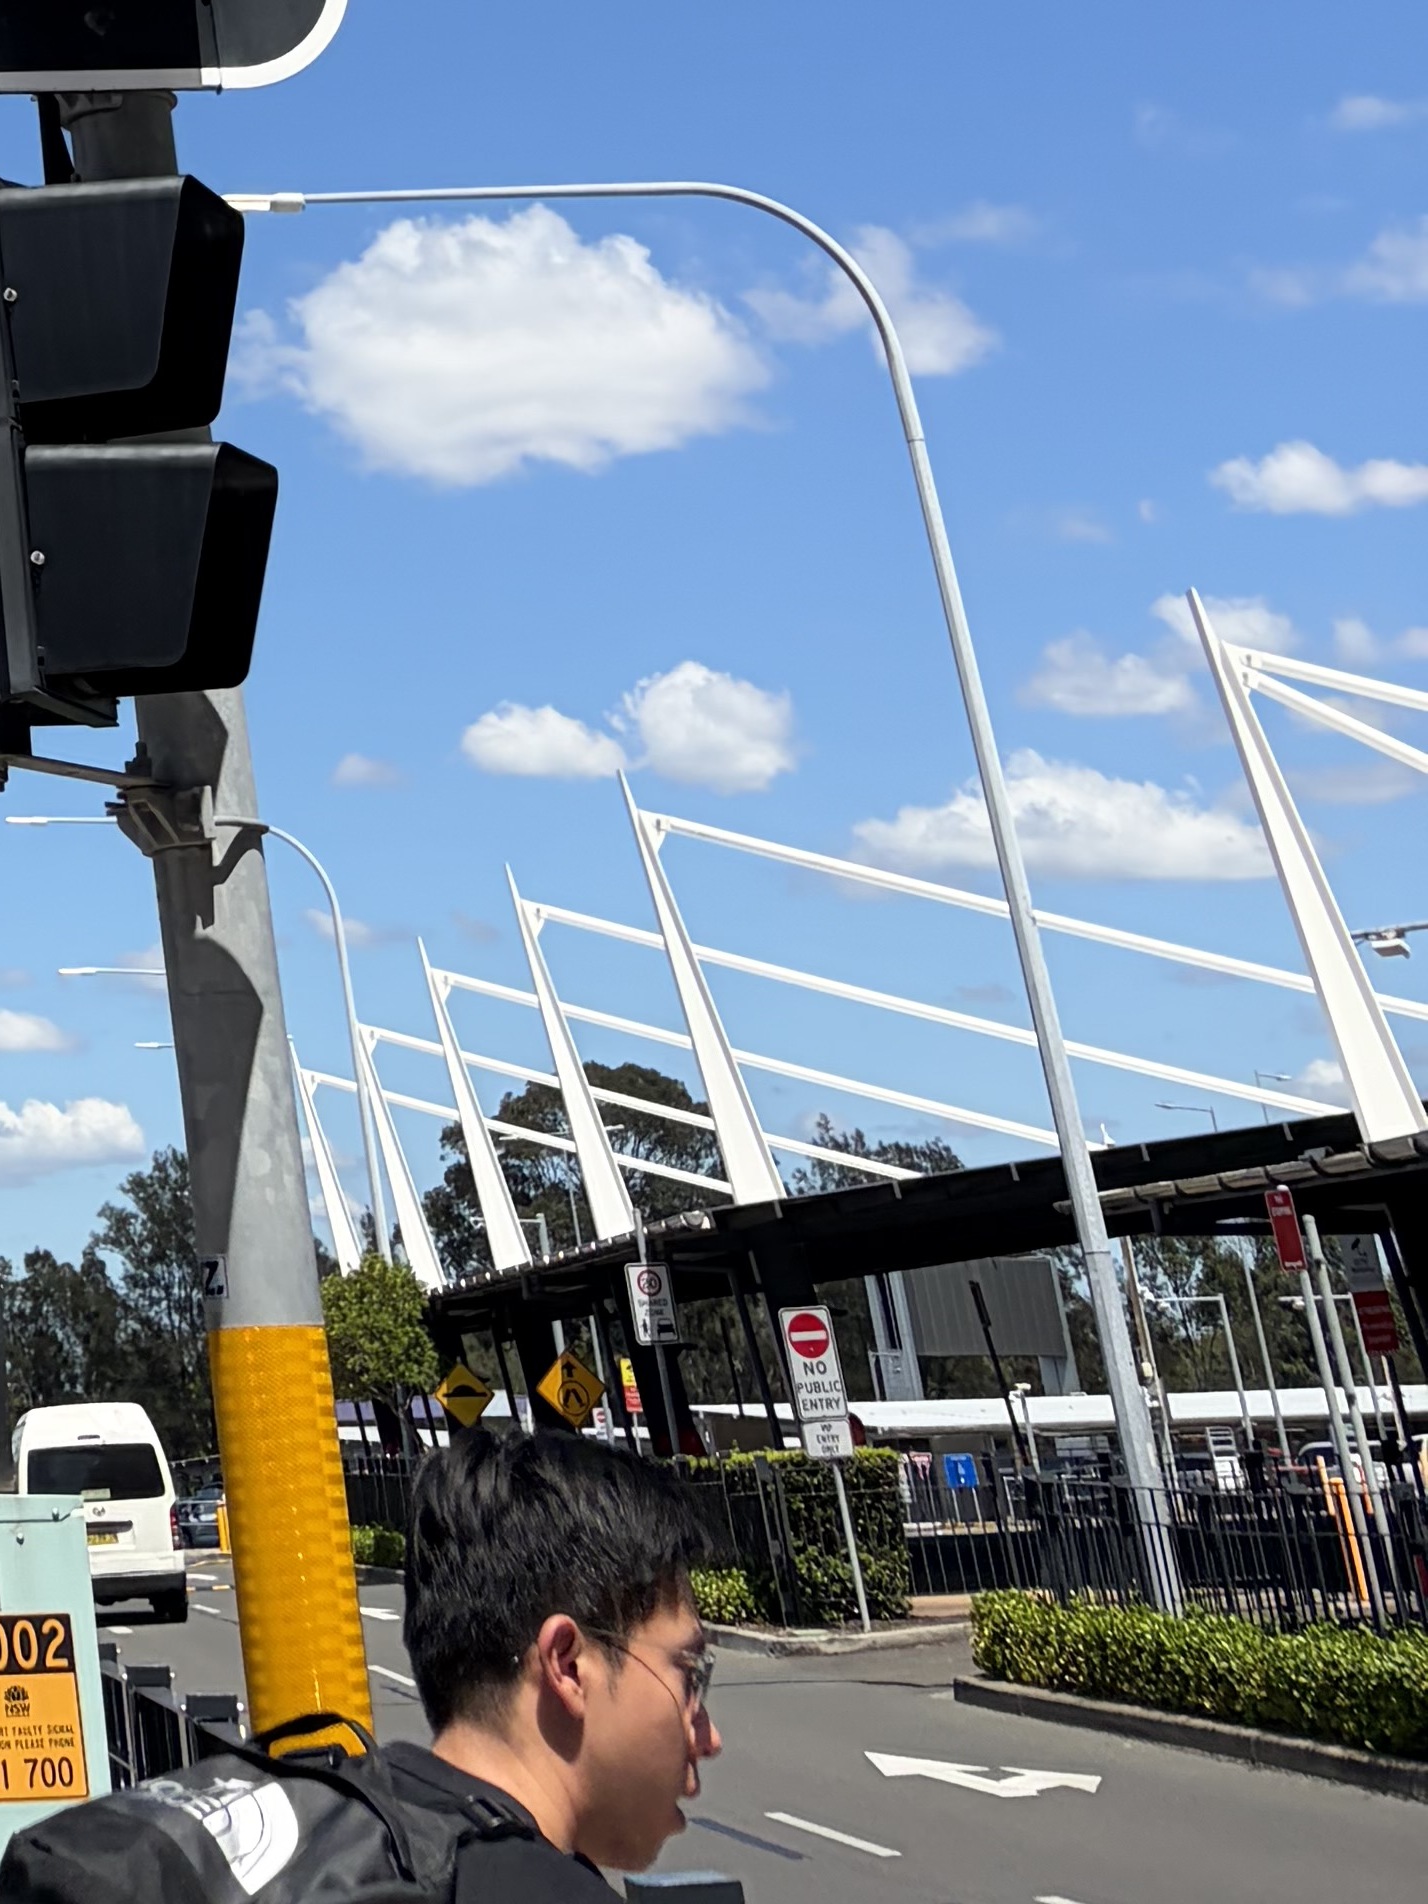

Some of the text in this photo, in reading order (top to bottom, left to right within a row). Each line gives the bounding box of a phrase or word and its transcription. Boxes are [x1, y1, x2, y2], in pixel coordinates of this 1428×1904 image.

[803, 1360, 827, 1376] NO
[797, 1380, 842, 1394] PUBLIC
[802, 1397, 841, 1411] ENTRY
[5, 1702, 31, 1715] NSW
[12, 1725, 43, 1736] FAULTY
[47, 1724, 75, 1735] SIGNAL
[15, 1739, 45, 1750] PLEASE
[49, 1737, 75, 1748] PHONE
[24, 1757, 74, 1788] 700
